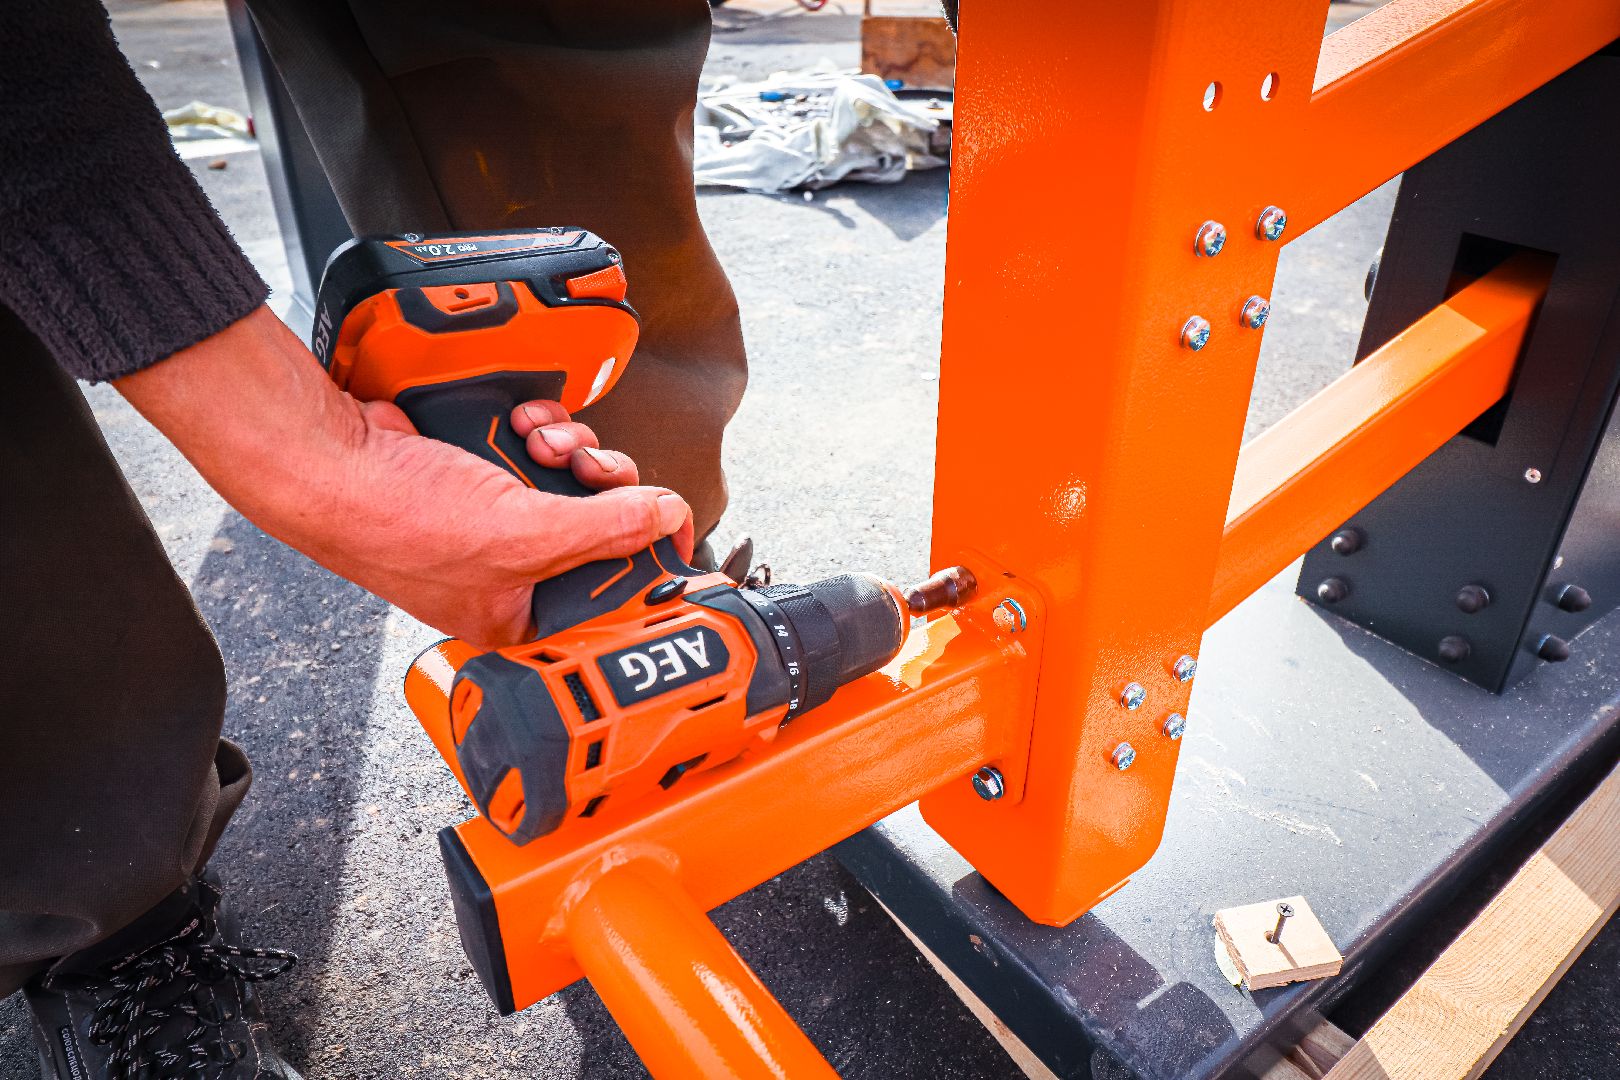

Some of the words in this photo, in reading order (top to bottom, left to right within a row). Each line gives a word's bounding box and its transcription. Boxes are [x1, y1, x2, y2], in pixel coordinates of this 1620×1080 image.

[315, 301, 333, 365] AEG
[773, 624, 789, 637] 14
[618, 631, 711, 692] AEG
[787, 661, 800, 676] 16
